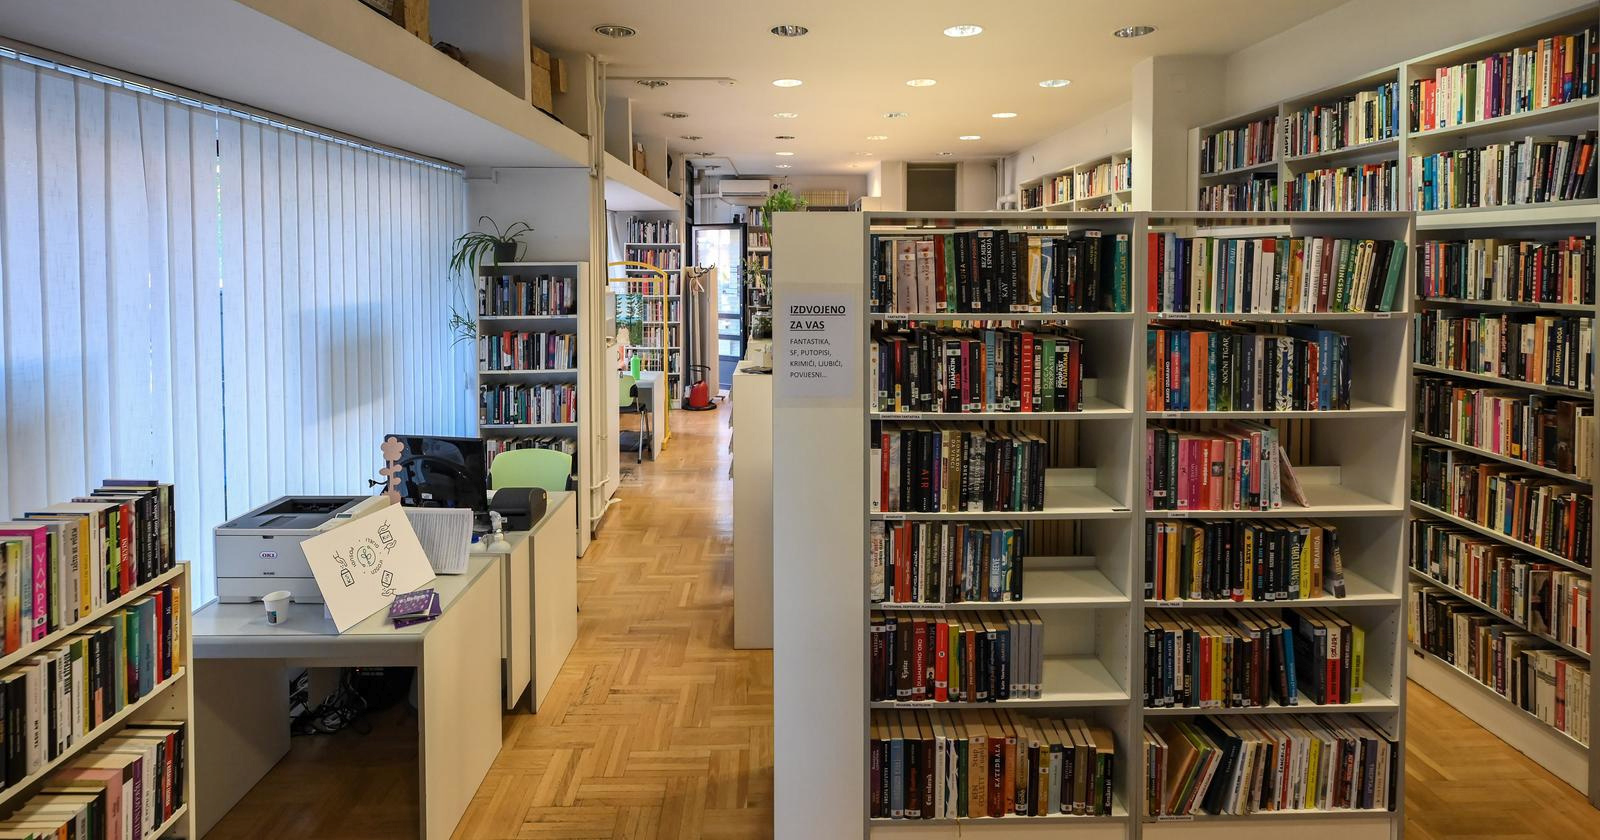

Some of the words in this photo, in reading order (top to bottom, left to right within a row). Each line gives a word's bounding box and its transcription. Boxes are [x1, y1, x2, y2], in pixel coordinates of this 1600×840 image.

[1001, 281, 1009, 298] KAY
[790, 305, 846, 315] IZDVOJENO
[790, 320, 803, 330] ZA
[805, 320, 825, 330] VAS
[790, 338, 831, 346] FANTASTIKA,
[1222, 336, 1230, 359] TIGAR
[790, 349, 800, 357] SF,
[800, 349, 832, 357] PUTOPISI,
[1220, 360, 1229, 384] NOĆNI
